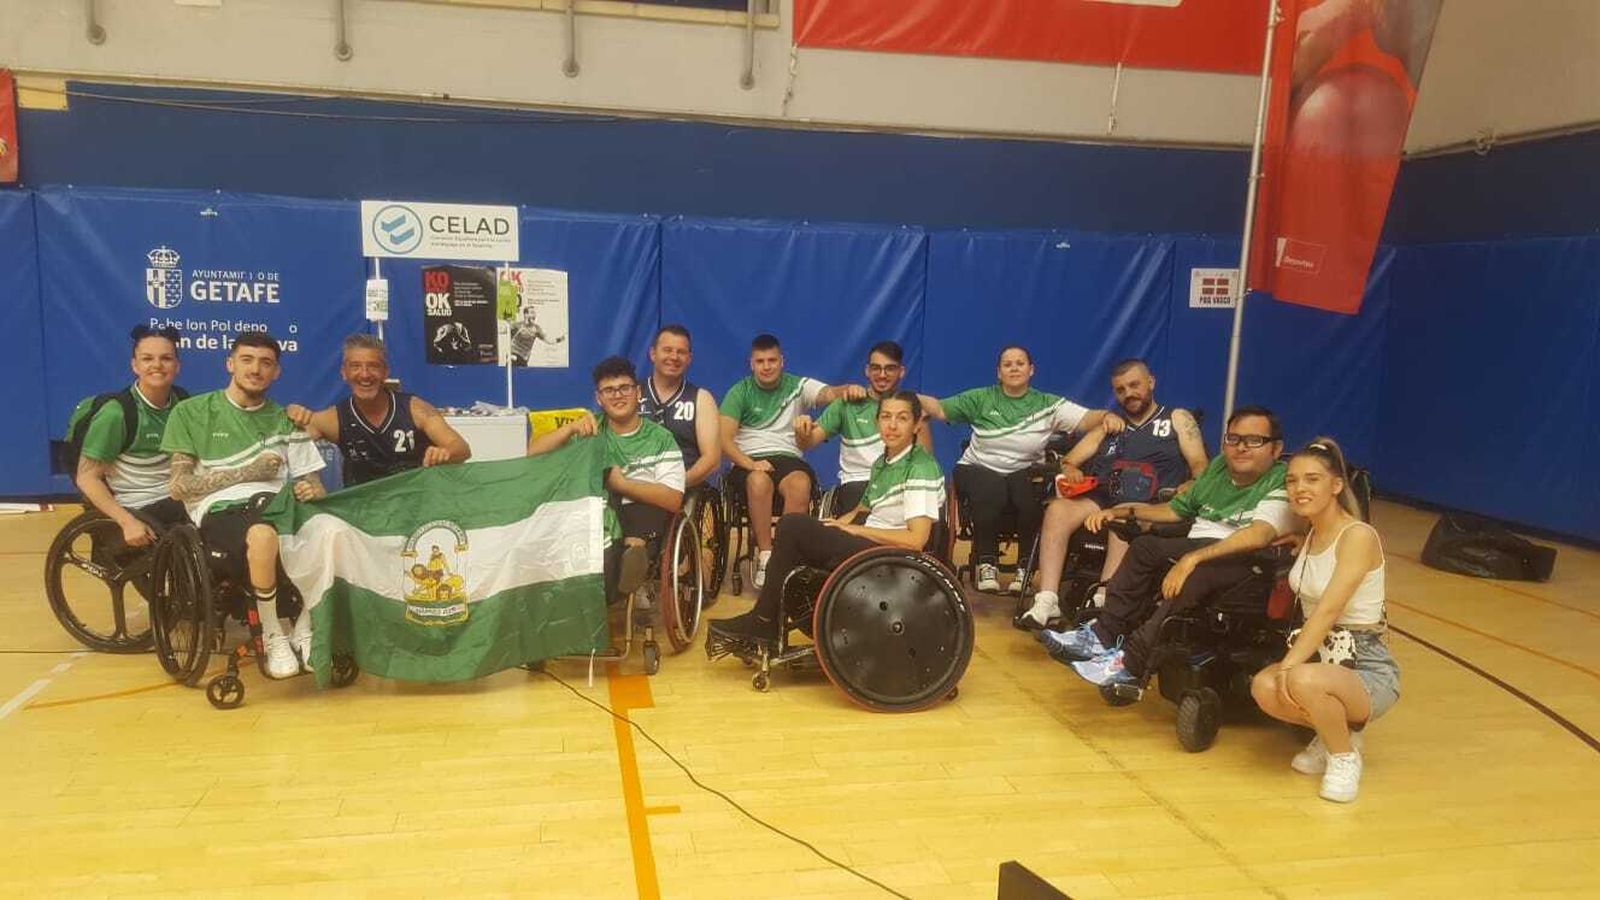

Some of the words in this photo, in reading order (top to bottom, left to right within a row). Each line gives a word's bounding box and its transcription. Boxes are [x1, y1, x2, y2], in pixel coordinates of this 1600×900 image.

[429, 215, 510, 235] CELAD
[192, 269, 265, 281] AYUNTAMIO
[267, 272, 280, 281] DE
[190, 281, 280, 303] GETAFE
[425, 292, 451, 309] OK
[427, 308, 452, 317] SALUD
[196, 334, 219, 350] de
[673, 401, 695, 421] 20
[1152, 418, 1172, 437] 13
[393, 429, 415, 453] 21
